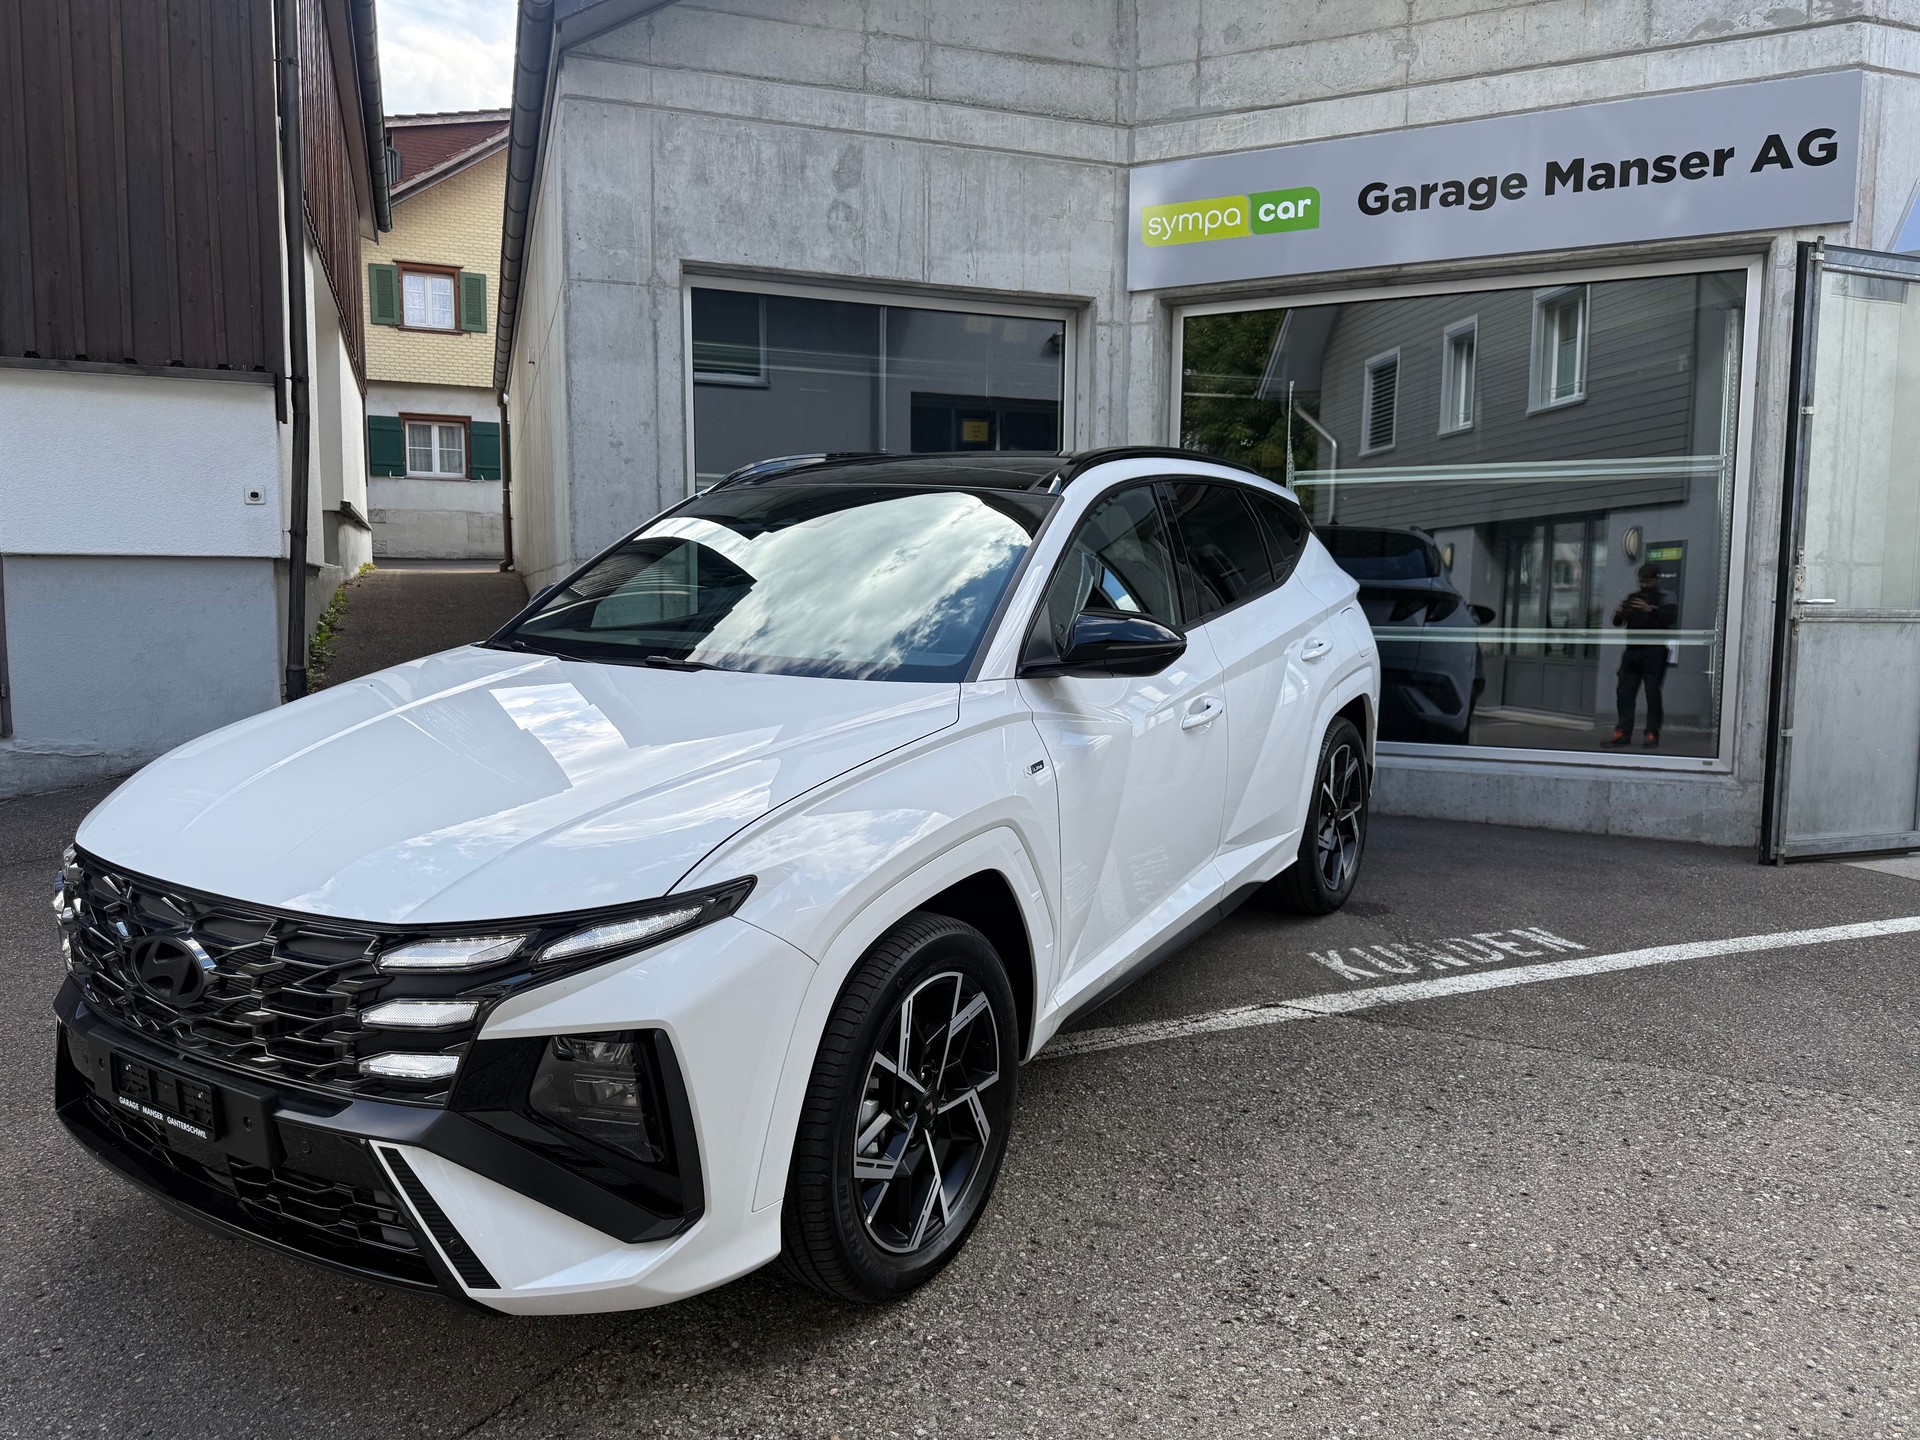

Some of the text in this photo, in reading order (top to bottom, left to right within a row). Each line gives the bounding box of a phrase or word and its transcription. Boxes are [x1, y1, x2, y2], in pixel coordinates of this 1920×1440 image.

[1357, 127, 1839, 217] Garage Manser AG
[1148, 197, 1312, 242] sympa car
[118, 1096, 208, 1140] GARAGE MANSER GANTERSCHWIL
